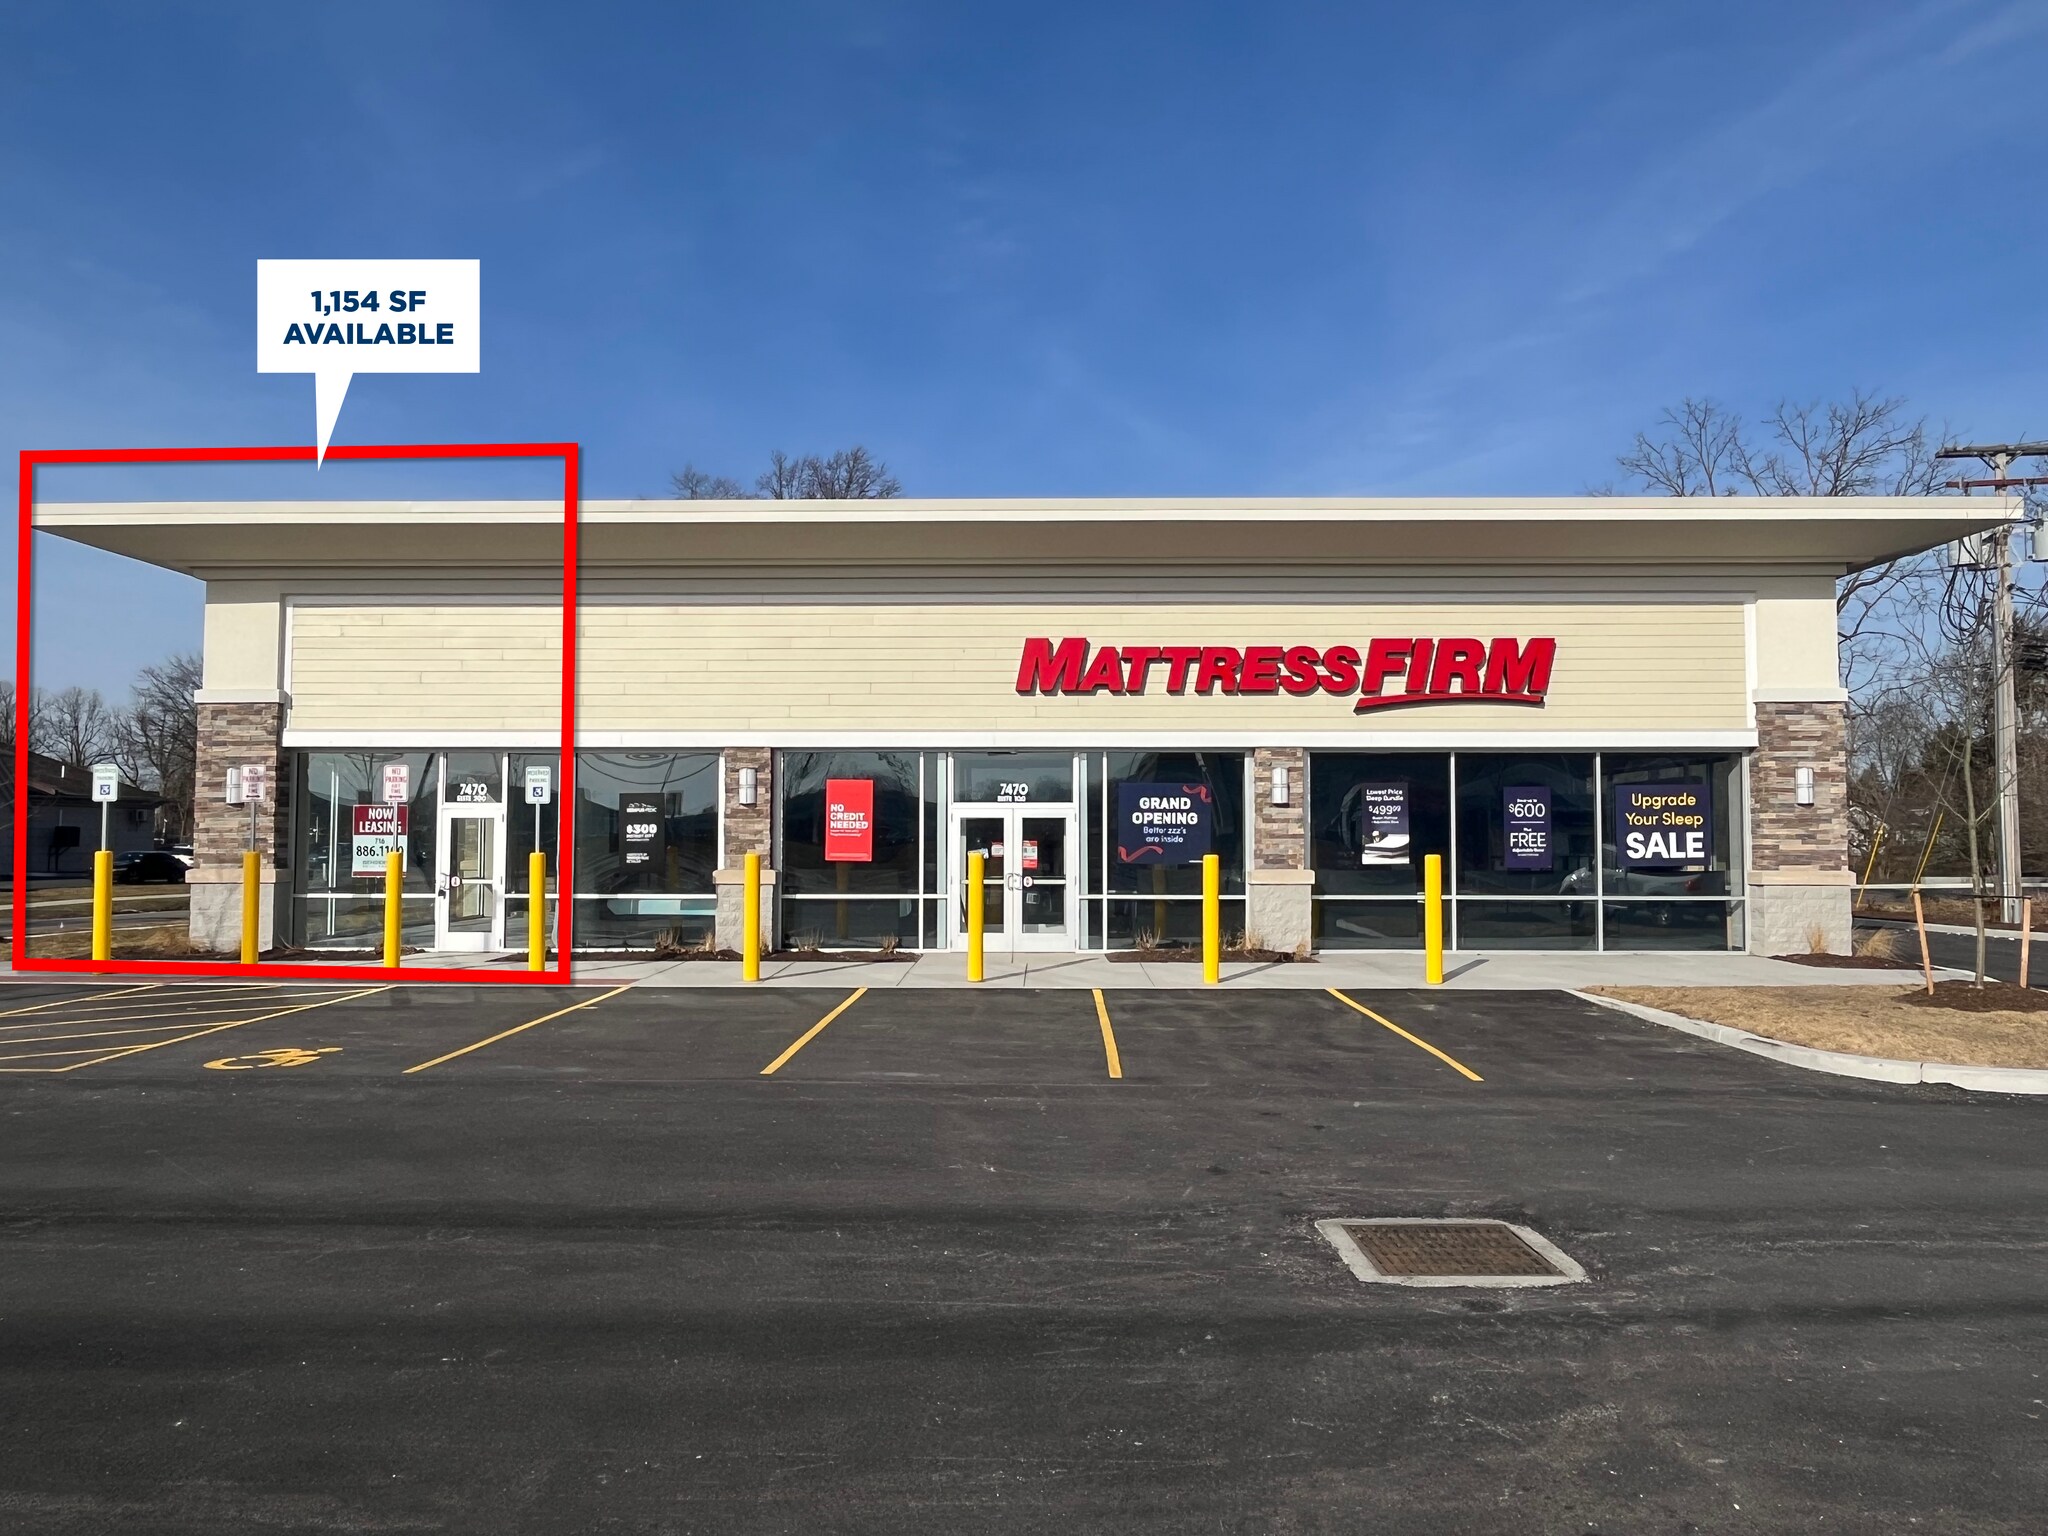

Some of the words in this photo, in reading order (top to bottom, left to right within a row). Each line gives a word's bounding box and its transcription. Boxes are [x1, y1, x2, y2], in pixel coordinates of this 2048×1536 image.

[460, 783, 487, 796] 7470
[1000, 783, 1029, 796] 7470
[1139, 797, 1192, 810] GRAND
[1631, 792, 1697, 810] Upgrade
[368, 808, 393, 820] NOW
[830, 804, 845, 812] NO
[1508, 803, 1546, 818] $600
[830, 812, 866, 821] CREDIT
[1131, 812, 1199, 825] OPENING
[1625, 812, 1659, 826] Your
[1661, 811, 1704, 829] Sleep
[830, 820, 869, 829] NEEDED
[1143, 826, 1167, 834] Better
[1160, 835, 1184, 843] inside
[1510, 832, 1547, 848] FREE
[1625, 831, 1706, 859] SALE
